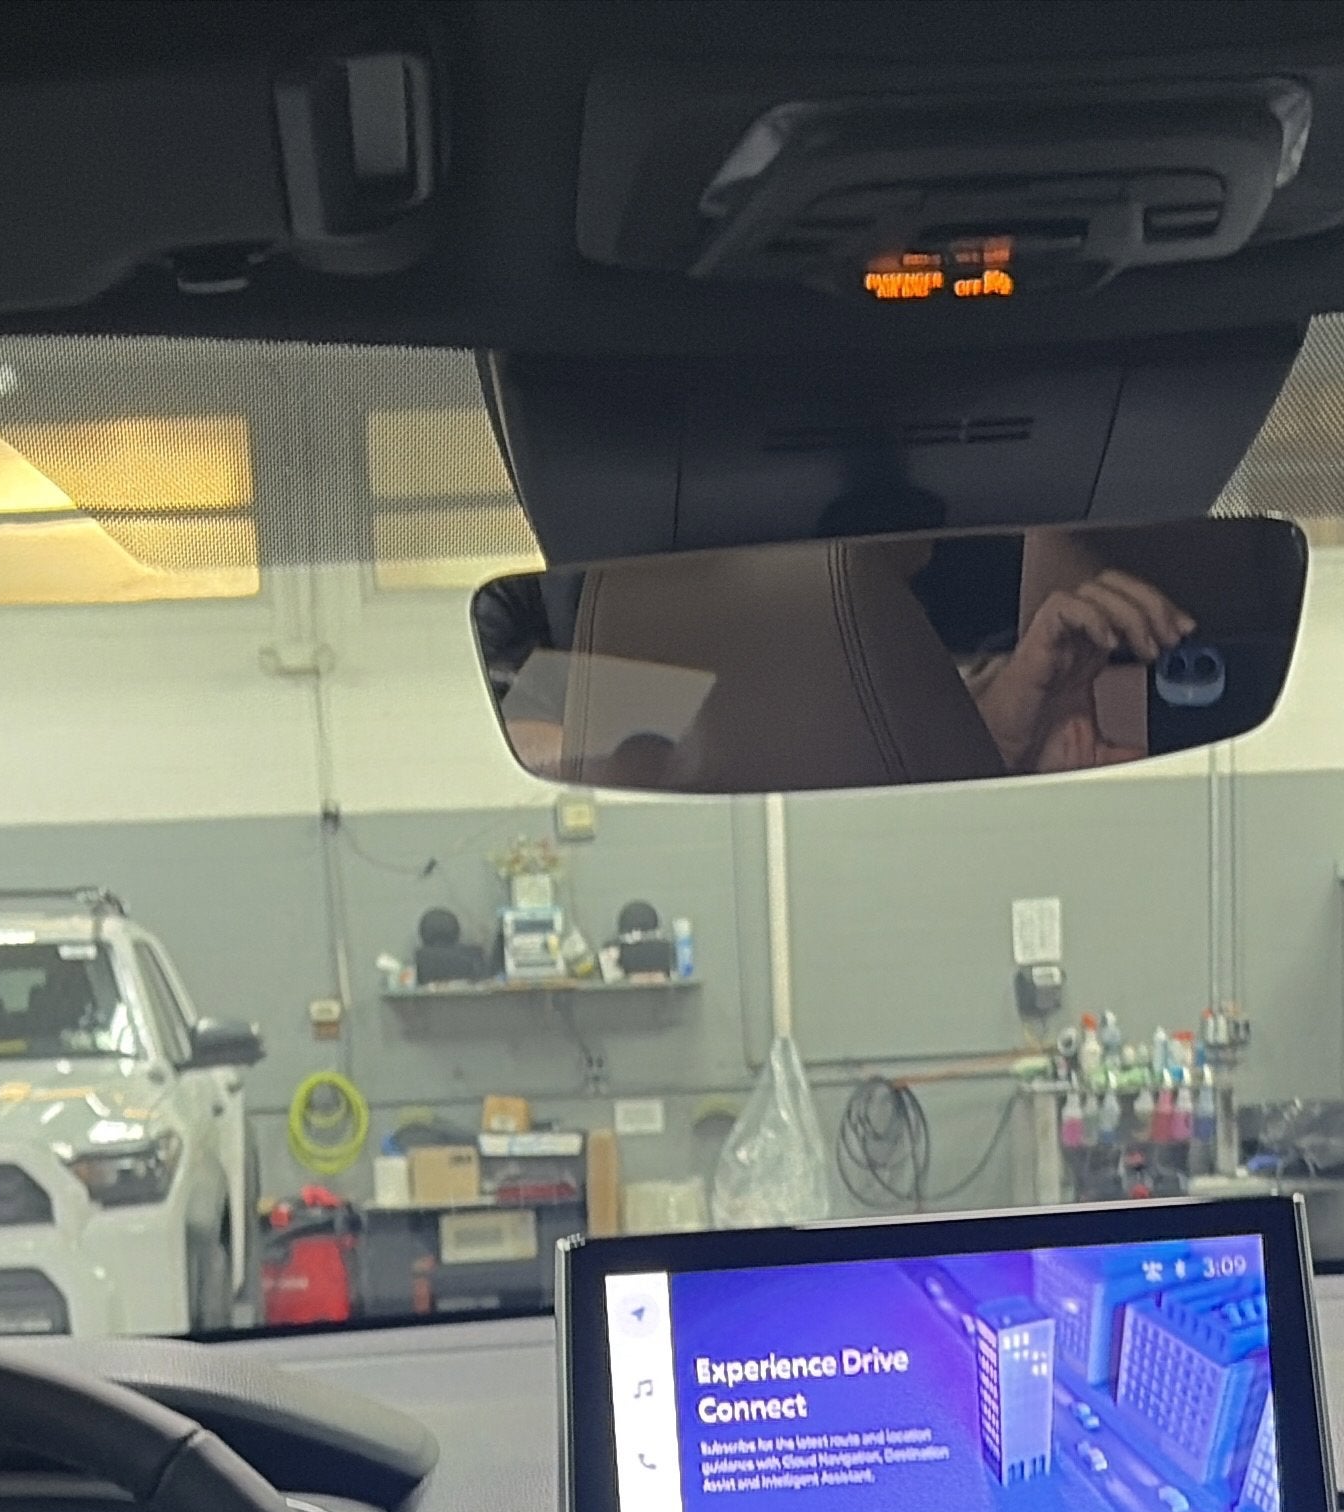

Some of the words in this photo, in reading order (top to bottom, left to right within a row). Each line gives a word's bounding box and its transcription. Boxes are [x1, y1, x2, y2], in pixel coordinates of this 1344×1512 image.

[1203, 1254, 1247, 1278] 3:09
[695, 1352, 838, 1387] Experience
[842, 1346, 909, 1375] Drive
[698, 1393, 808, 1423] Connect
